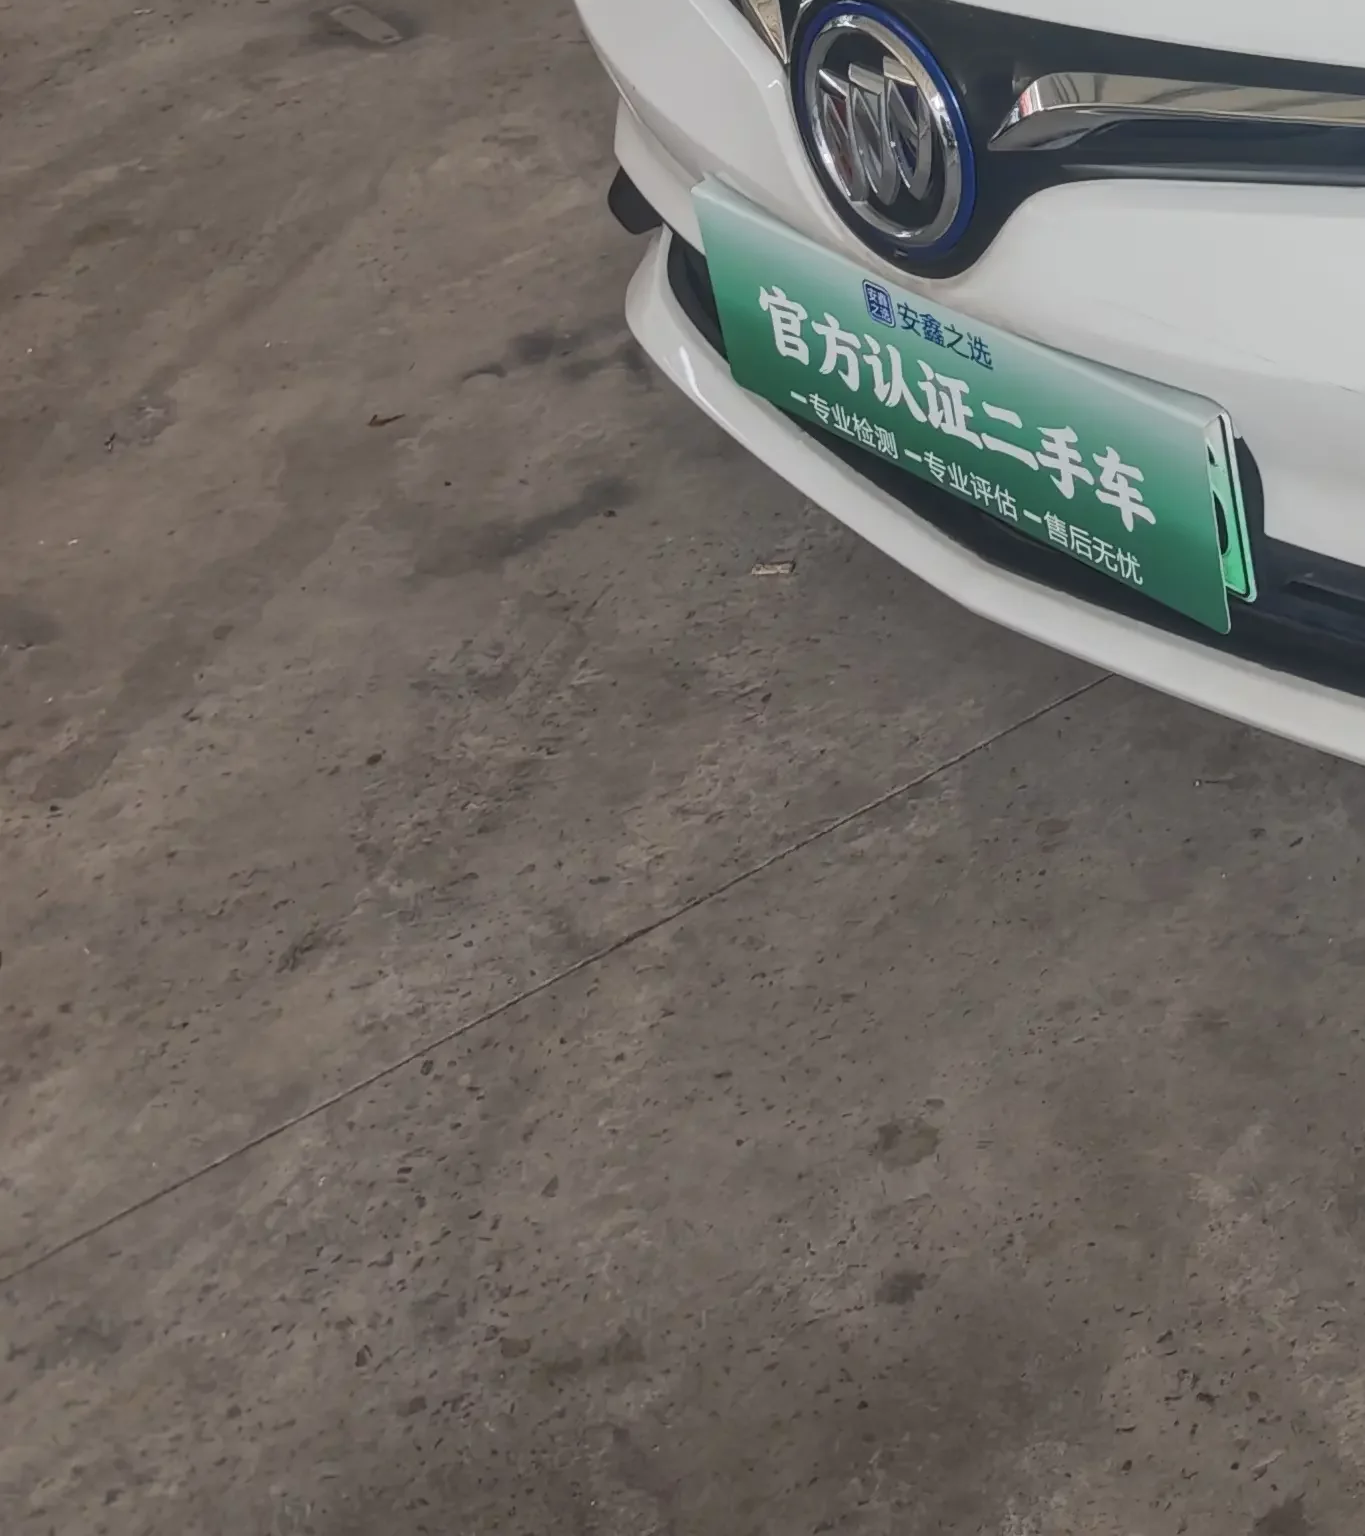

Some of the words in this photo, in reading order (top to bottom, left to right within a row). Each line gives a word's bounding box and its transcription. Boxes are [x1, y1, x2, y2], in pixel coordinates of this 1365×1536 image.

[758, 285, 1157, 533] 官方认证二手车
[896, 302, 994, 370] 安鑫之选
